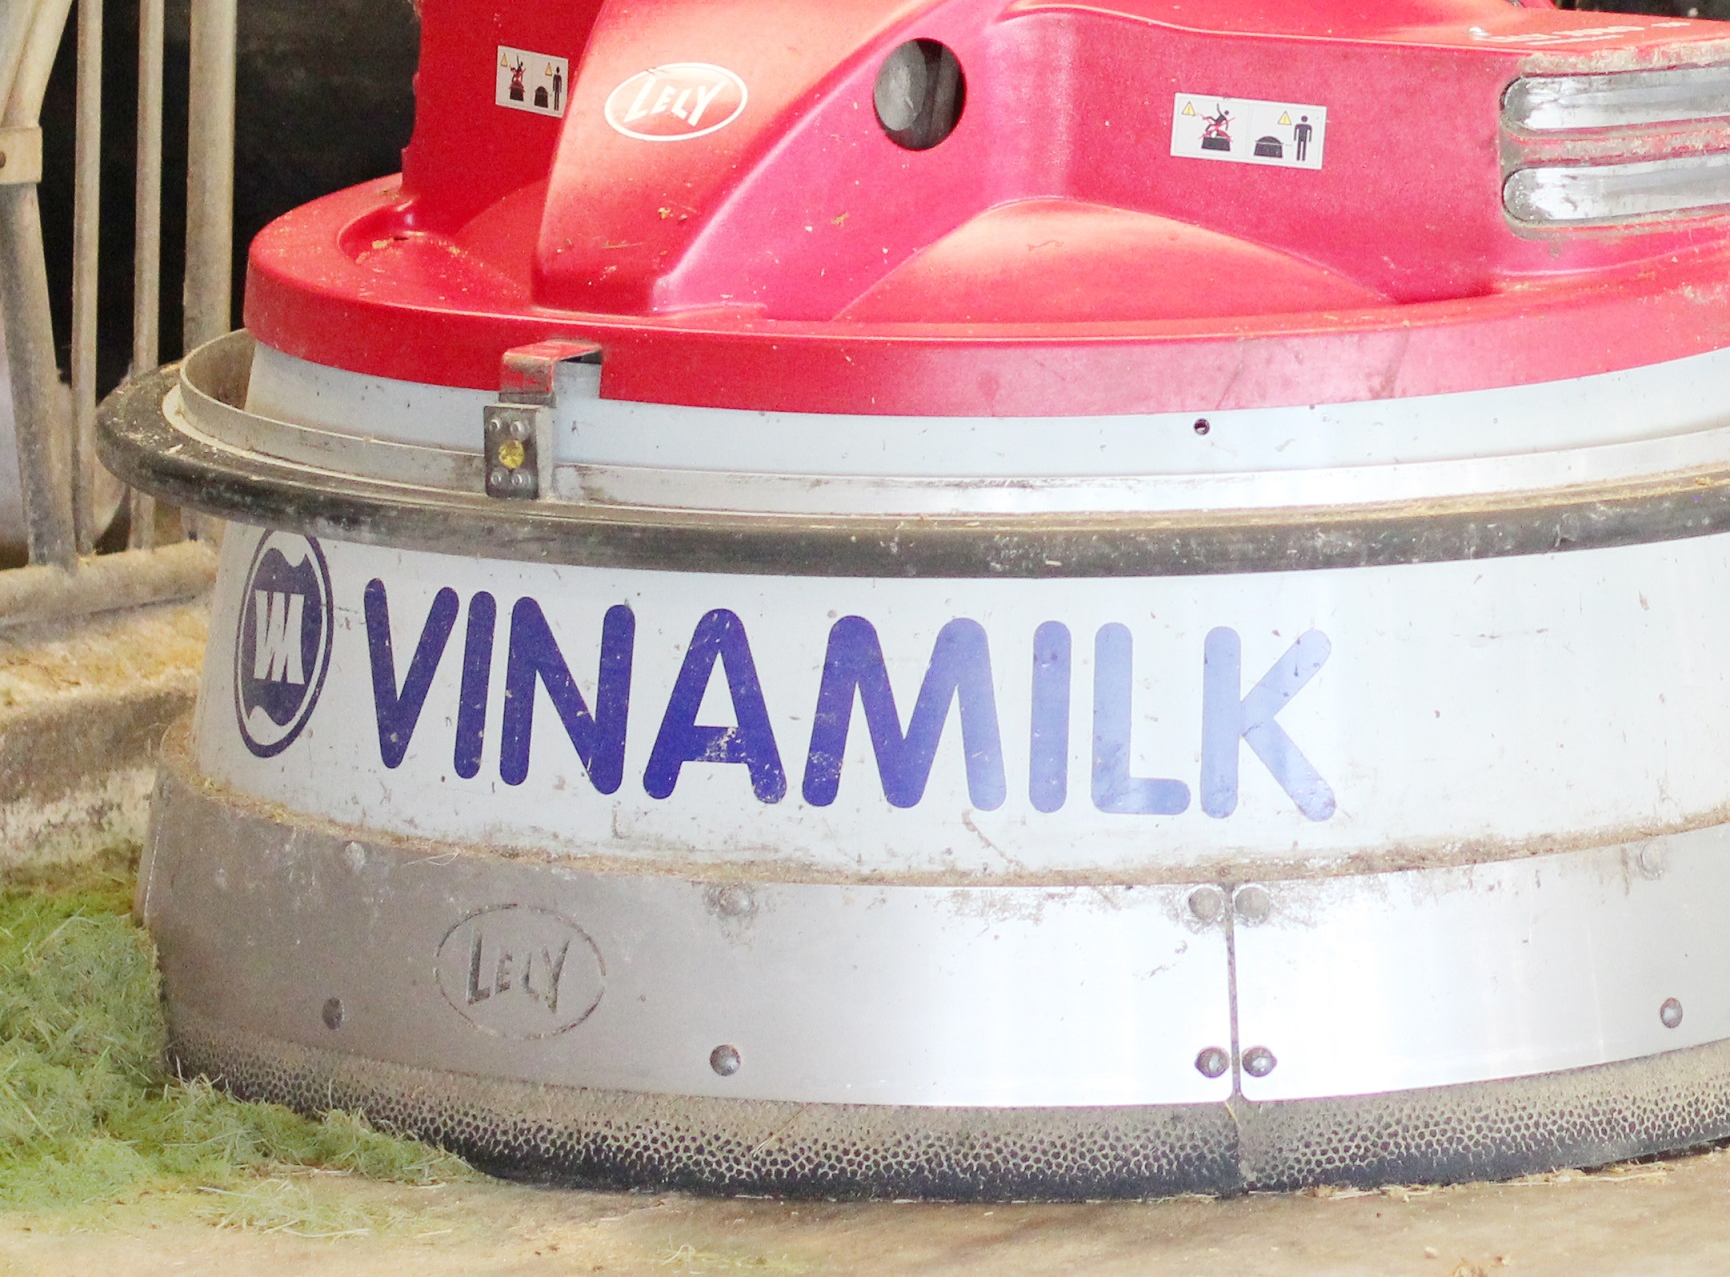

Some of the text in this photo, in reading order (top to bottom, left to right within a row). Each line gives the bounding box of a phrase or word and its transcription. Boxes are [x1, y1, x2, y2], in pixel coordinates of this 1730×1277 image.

[623, 75, 728, 127] LELY
[362, 577, 1336, 822] VINAMILK
[466, 925, 571, 1013] LELY
